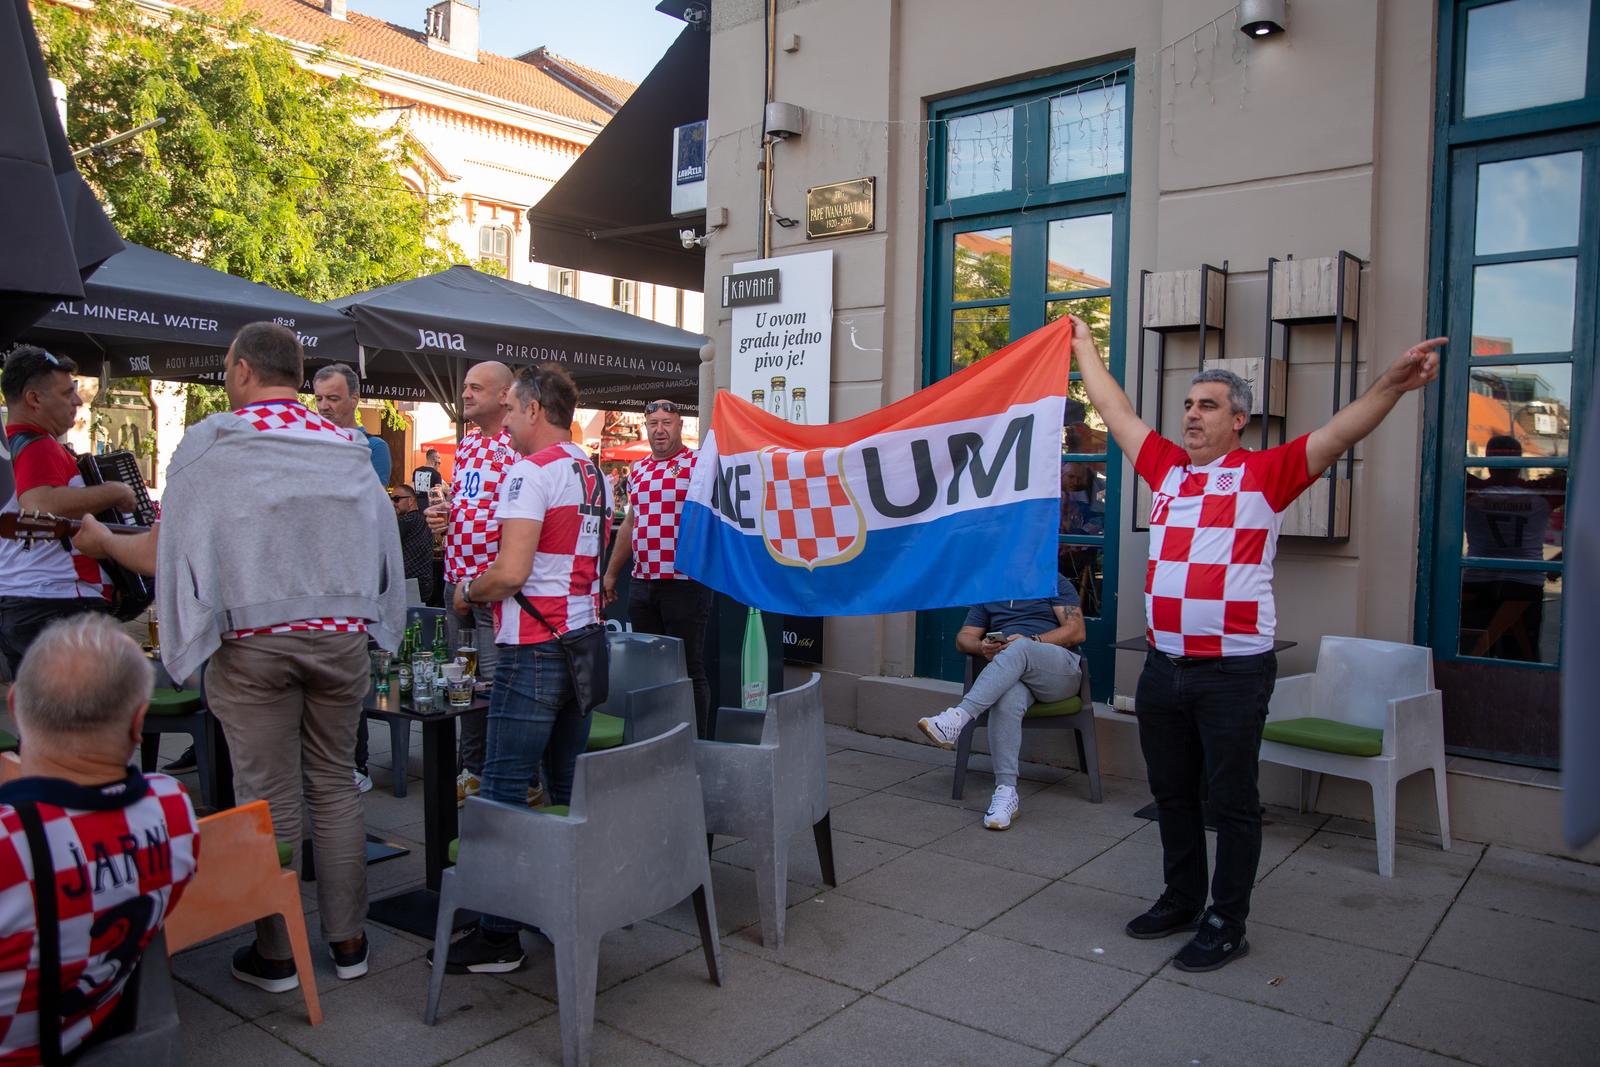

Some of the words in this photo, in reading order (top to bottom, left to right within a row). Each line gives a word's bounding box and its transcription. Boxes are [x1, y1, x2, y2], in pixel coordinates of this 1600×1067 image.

[810, 207, 824, 221] PAPE
[825, 203, 843, 219] IVANA
[843, 200, 864, 216] PAVLA
[864, 199, 869, 213] II
[826, 218, 837, 228] 1920
[731, 276, 774, 300] KAVANA
[52, 302, 79, 315] AL
[83, 303, 160, 325] MINERAL
[164, 314, 219, 332] WATER
[272, 316, 295, 327] 1828
[755, 312, 767, 328] U
[769, 311, 807, 326] ovom
[416, 328, 466, 351] Jana
[739, 331, 779, 353] gradu
[782, 328, 822, 350] jedno
[496, 343, 567, 362] PRIRODNA
[574, 351, 645, 370] MINERALNA
[650, 359, 682, 374] VODA
[754, 352, 783, 372] pivo
[786, 350, 805, 371] je!
[861, 413, 1035, 519] UM
[462, 471, 480, 498] 10
